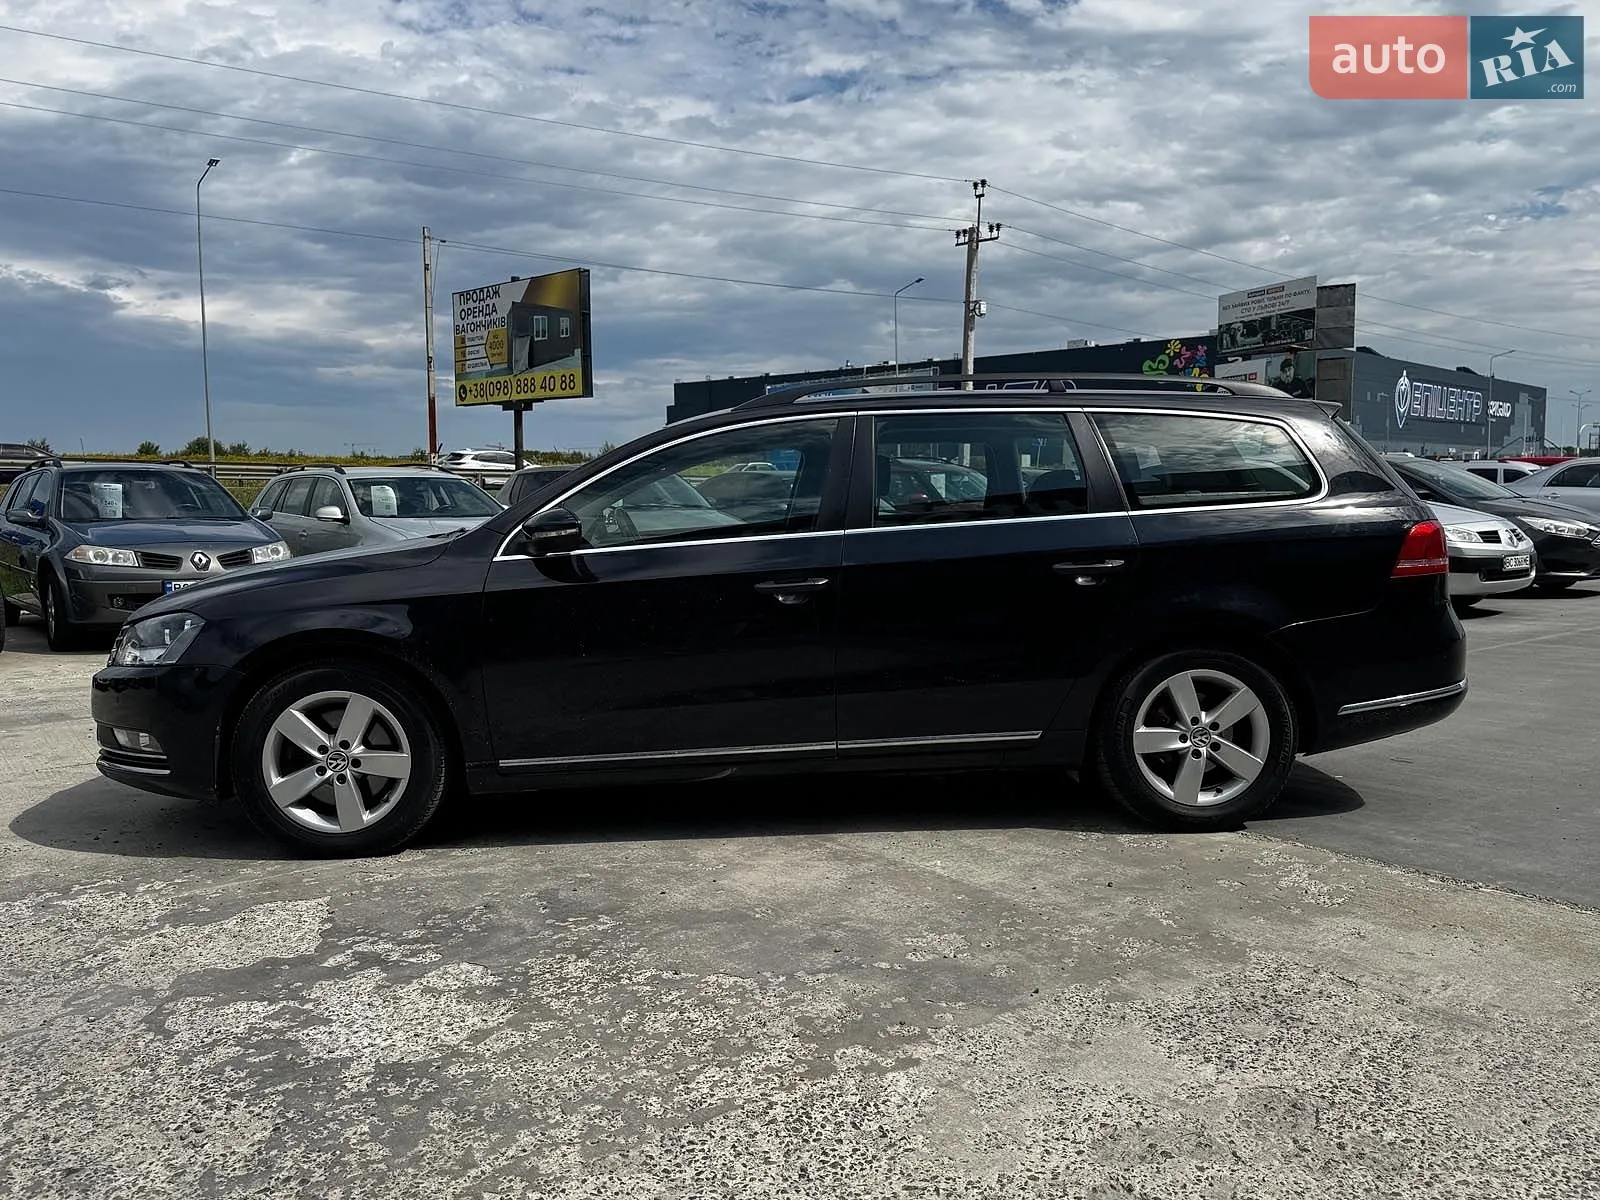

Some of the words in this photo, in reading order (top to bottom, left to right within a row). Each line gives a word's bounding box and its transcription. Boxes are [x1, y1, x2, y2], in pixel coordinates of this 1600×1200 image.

[459, 286, 501, 306] ПРОДАЖ
[459, 303, 498, 321] ОРЕНДА
[455, 316, 506, 335] ВАГОНЧИКІВ
[468, 377, 513, 401] +38(098)
[515, 376, 536, 395] 888
[540, 375, 556, 393] 40
[560, 373, 576, 391] 88
[1410, 381, 1483, 422] ЕПІЦЕНТР
